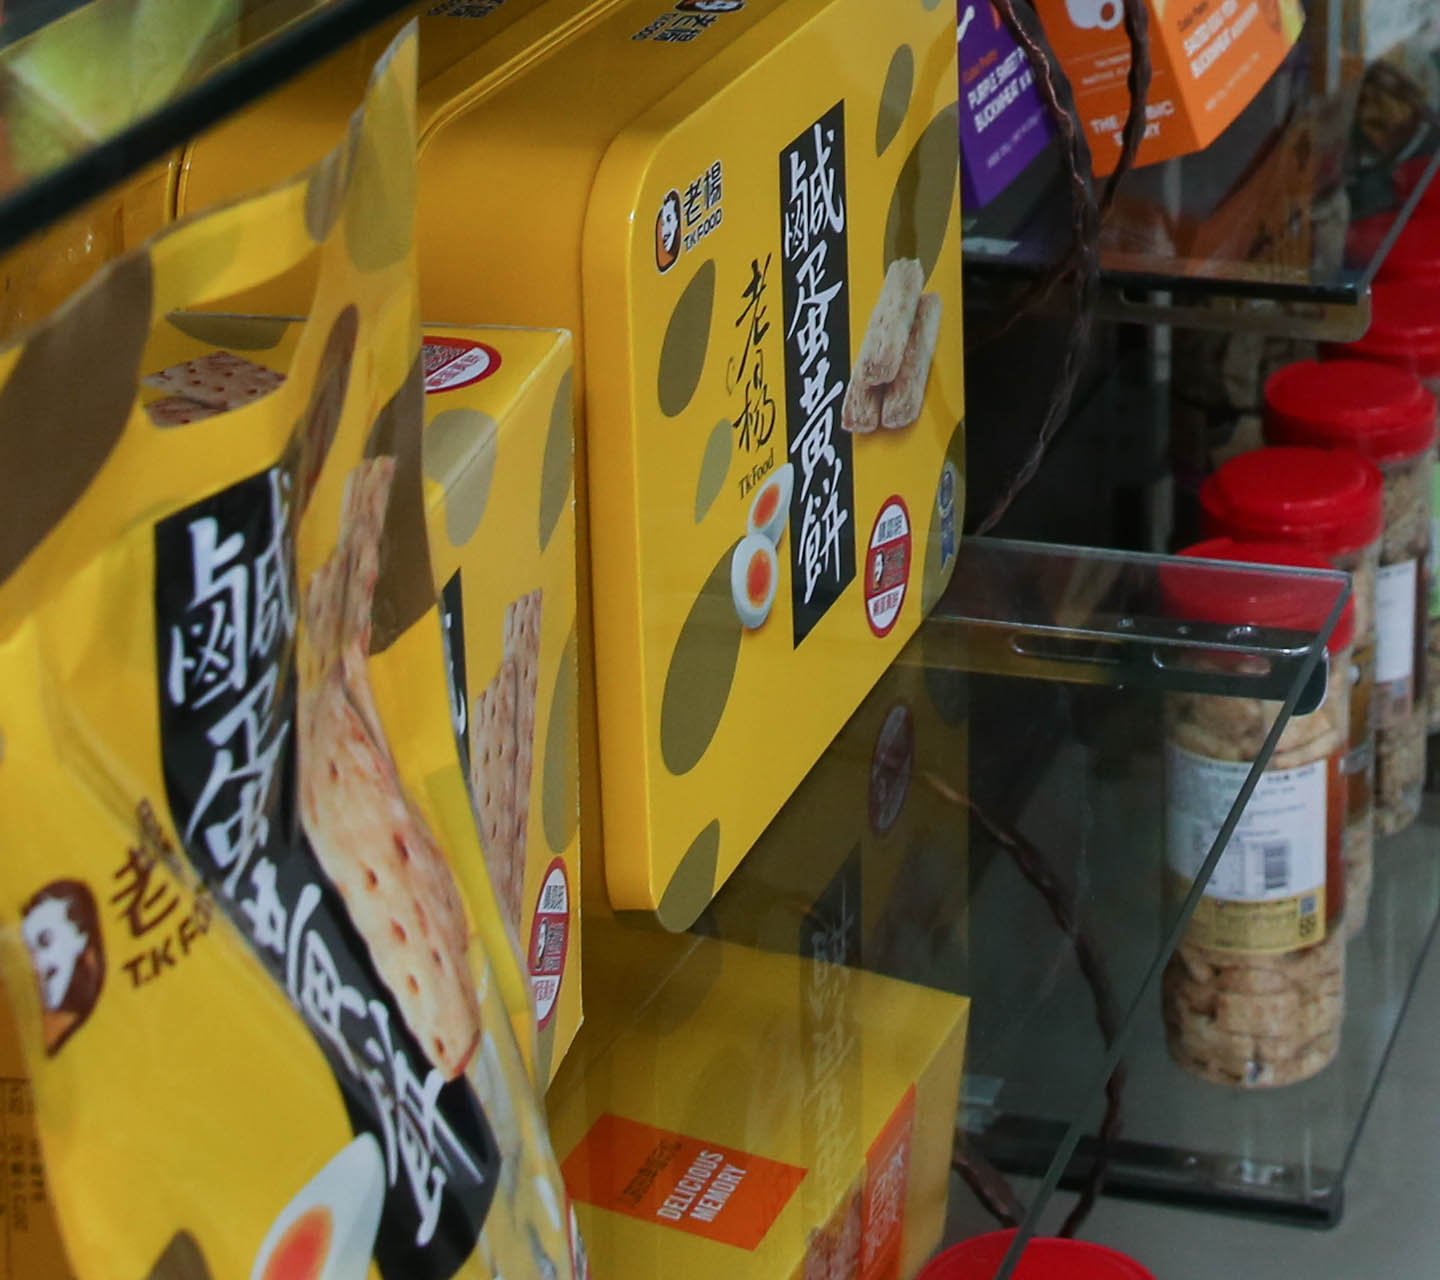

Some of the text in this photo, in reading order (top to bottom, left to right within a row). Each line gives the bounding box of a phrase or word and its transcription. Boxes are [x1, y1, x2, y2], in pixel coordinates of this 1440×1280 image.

[683, 159, 723, 225] 老楊
[695, 209, 723, 247] FOOD
[783, 121, 847, 607] 鹹蛋黃餅
[657, 1148, 726, 1222] DELICIOUS
[690, 1164, 748, 1224] MEMORY
